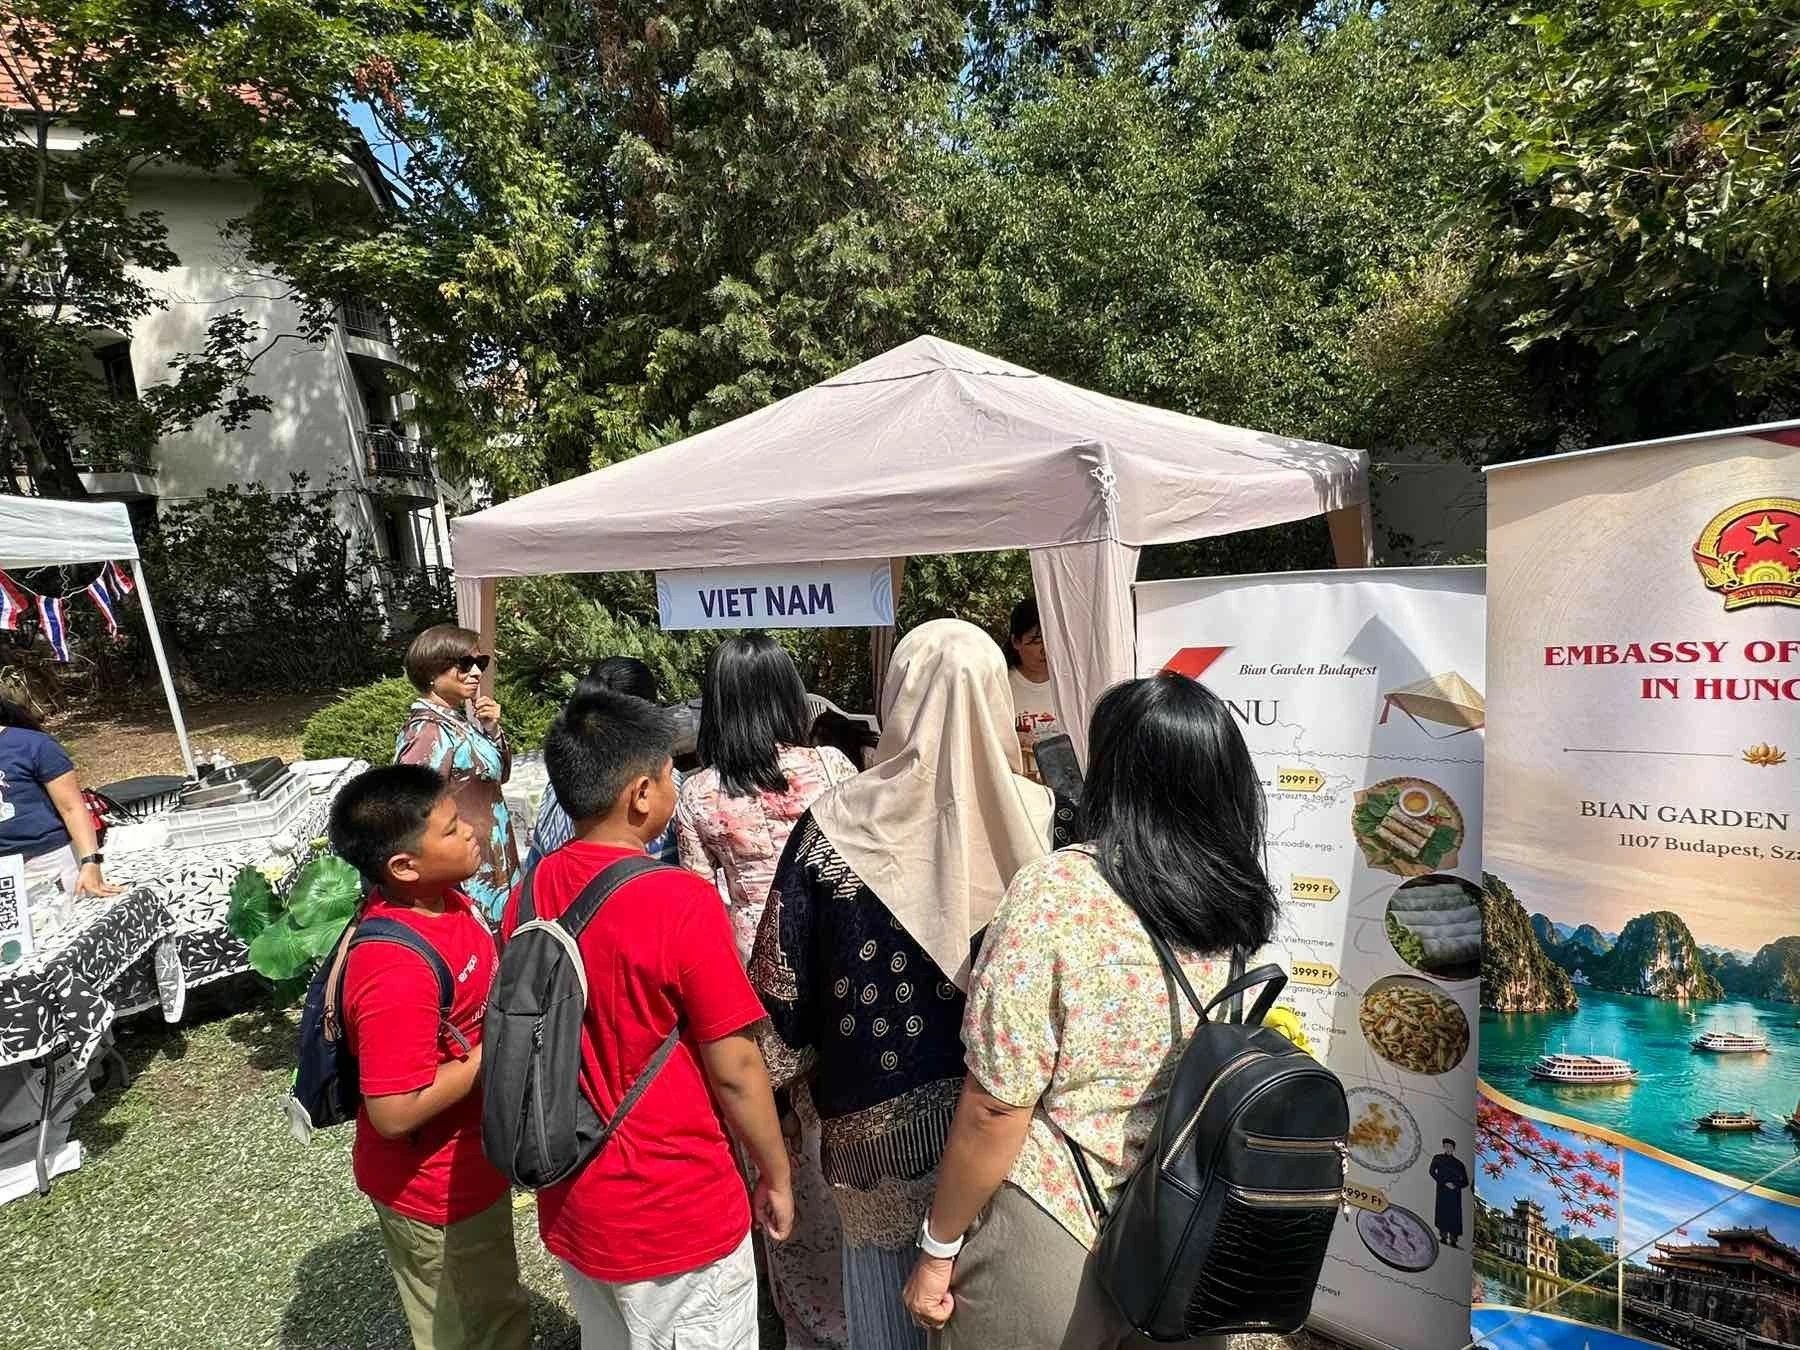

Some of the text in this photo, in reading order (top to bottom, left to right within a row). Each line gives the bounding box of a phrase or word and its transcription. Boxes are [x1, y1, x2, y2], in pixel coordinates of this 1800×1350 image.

[698, 583, 835, 618] VIET NAM
[1543, 640, 1800, 666] EMBASSY OF
[1239, 664, 1377, 678] Bian Garden Budapest
[1640, 678, 1680, 699] IN
[1223, 699, 1280, 726] NU
[1279, 774, 1306, 785] 2999
[1308, 776, 1319, 785] Ft
[1581, 800, 1790, 831] BIAN GARDEN
[1617, 833, 1660, 849] 1107
[1665, 836, 1765, 859] Budapest,
[1293, 882, 1320, 893] 2999
[1322, 884, 1333, 894] Ft
[1292, 966, 1333, 979] 3999 Ft
[1371, 1194, 1382, 1207] Ft
